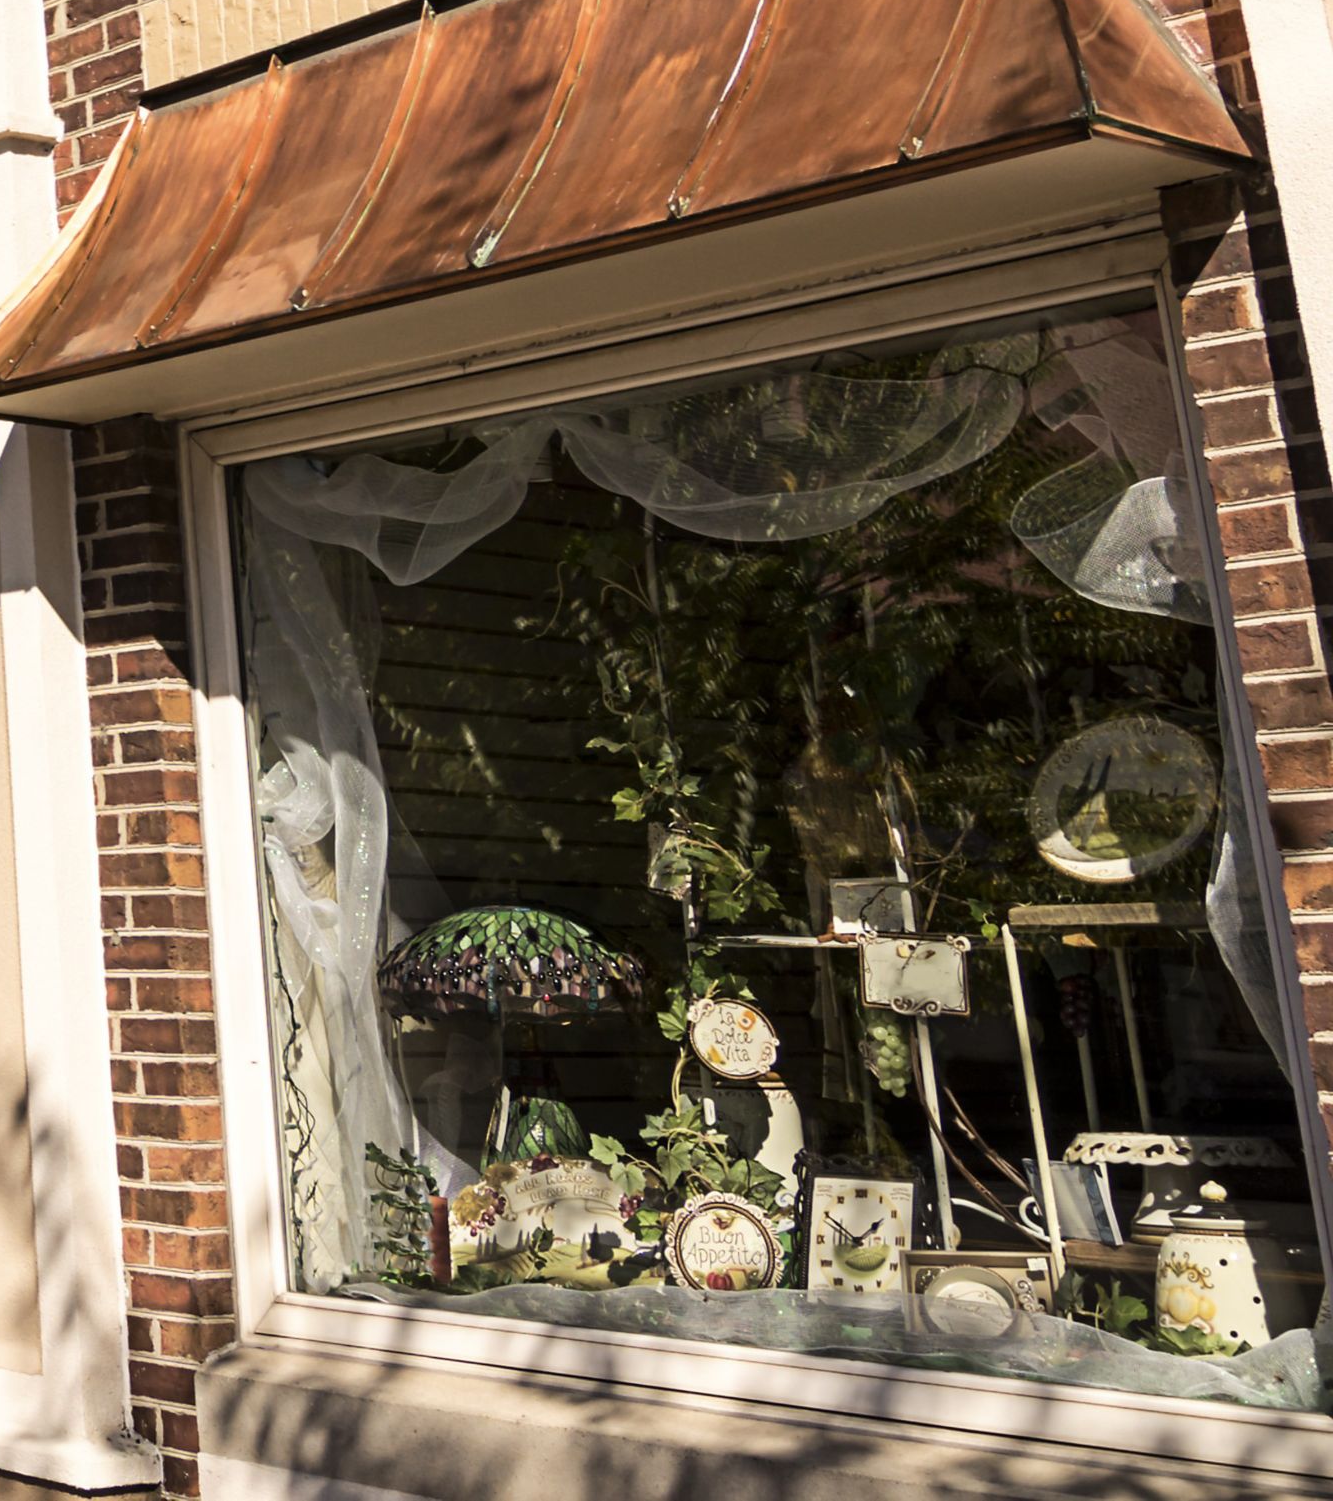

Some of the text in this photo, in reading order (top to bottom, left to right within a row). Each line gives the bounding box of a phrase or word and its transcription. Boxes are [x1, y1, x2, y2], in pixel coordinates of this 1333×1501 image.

[719, 1006, 736, 1026] La
[712, 1027, 754, 1046] Dolce
[721, 1045, 751, 1062] Vita
[699, 1226, 746, 1245] Buon
[683, 1243, 764, 1268] Appetito
